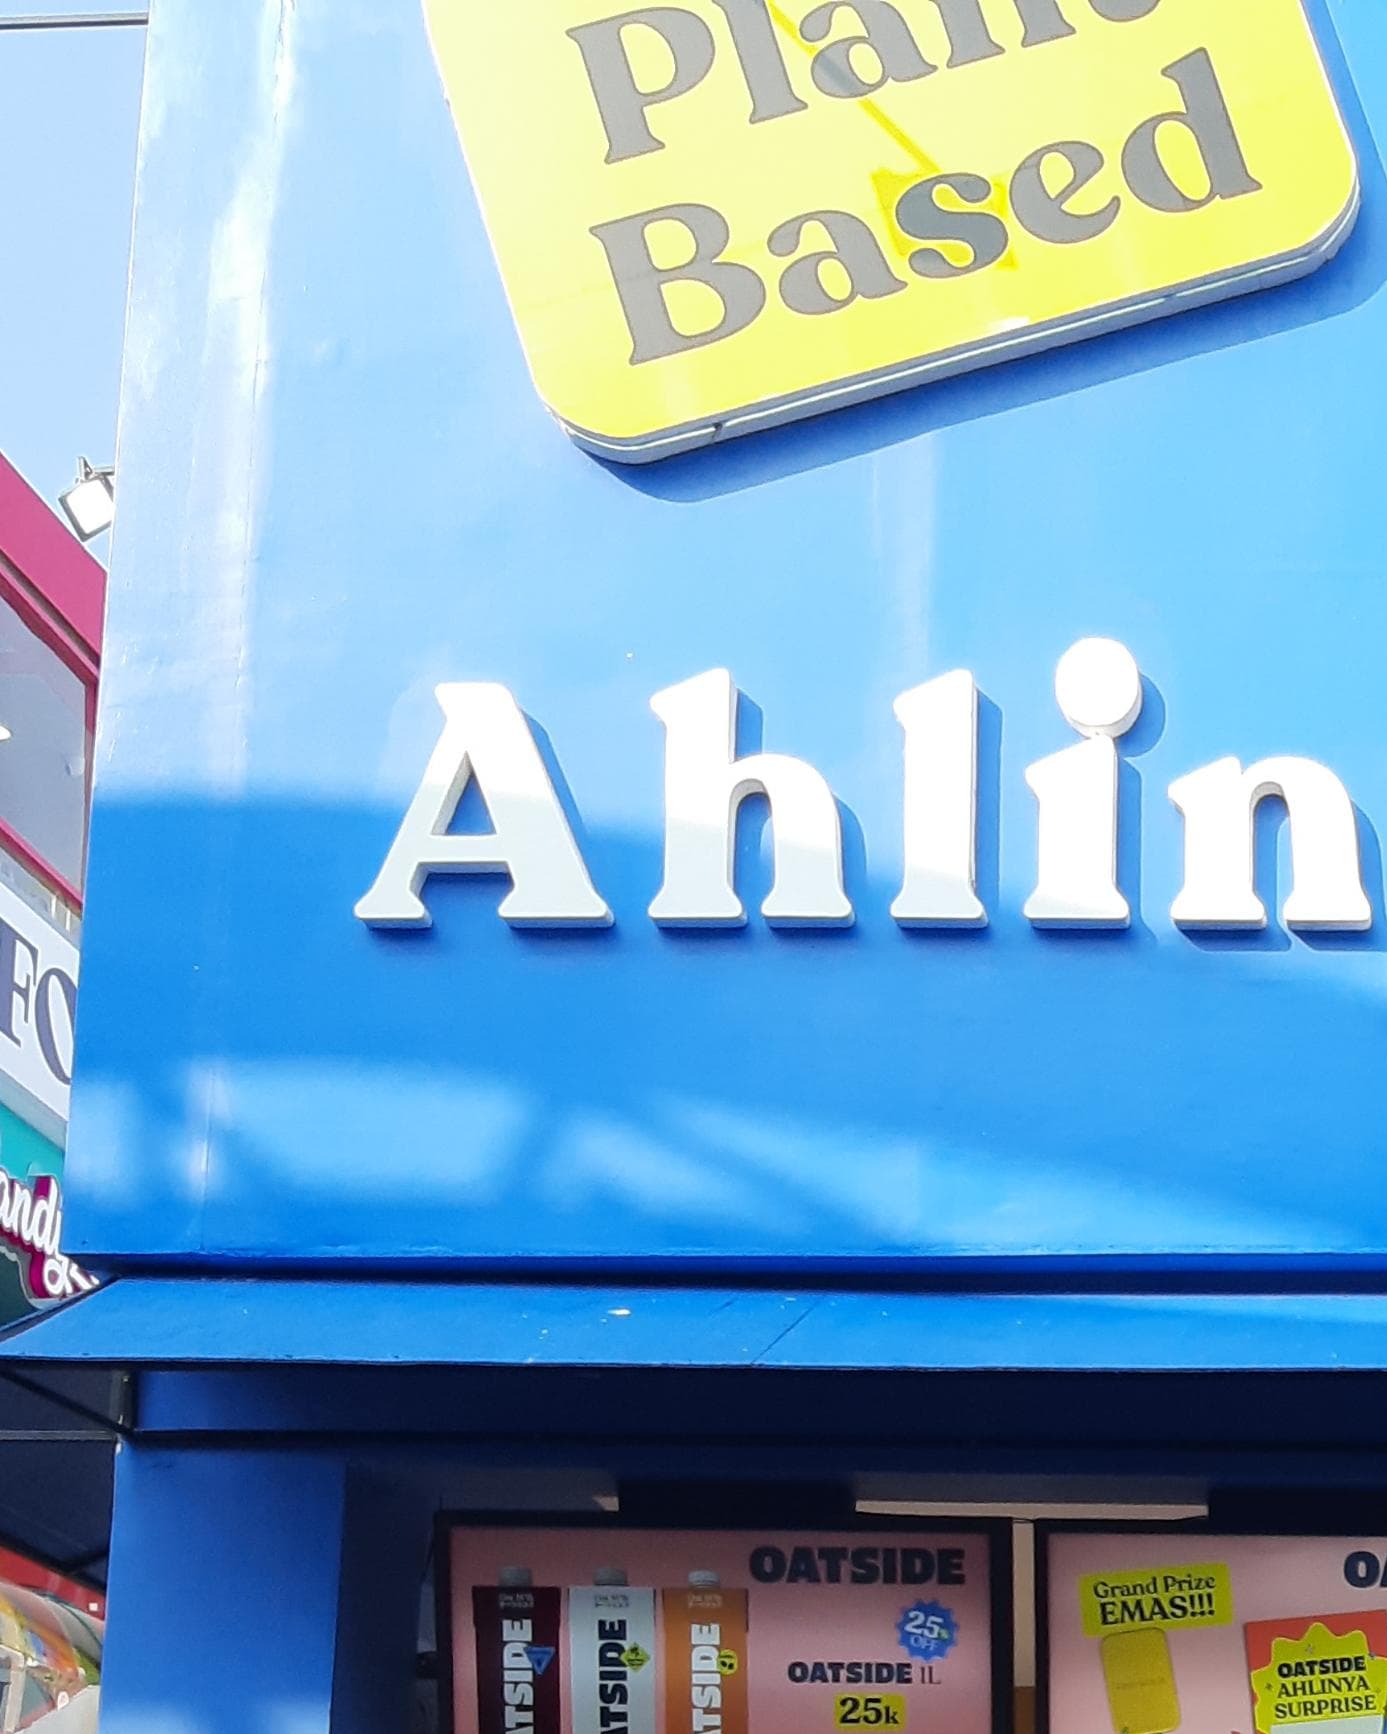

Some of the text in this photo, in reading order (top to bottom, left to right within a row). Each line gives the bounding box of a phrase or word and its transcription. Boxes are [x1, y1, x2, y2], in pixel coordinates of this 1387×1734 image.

[566, 0, 1162, 165] Plan
[590, 47, 1263, 366] Based
[750, 1546, 965, 1585] OATSIDE
[1093, 1573, 1216, 1598] Grand Prize
[1100, 1593, 1215, 1625] EMAS!!!
[788, 1661, 913, 1684] OATSIDE
[1277, 1656, 1366, 1679] OATSIDE
[1277, 1675, 1369, 1699] AHLINYA
[839, 1696, 899, 1725] 25k
[1275, 1694, 1377, 1719] SURPRISE
